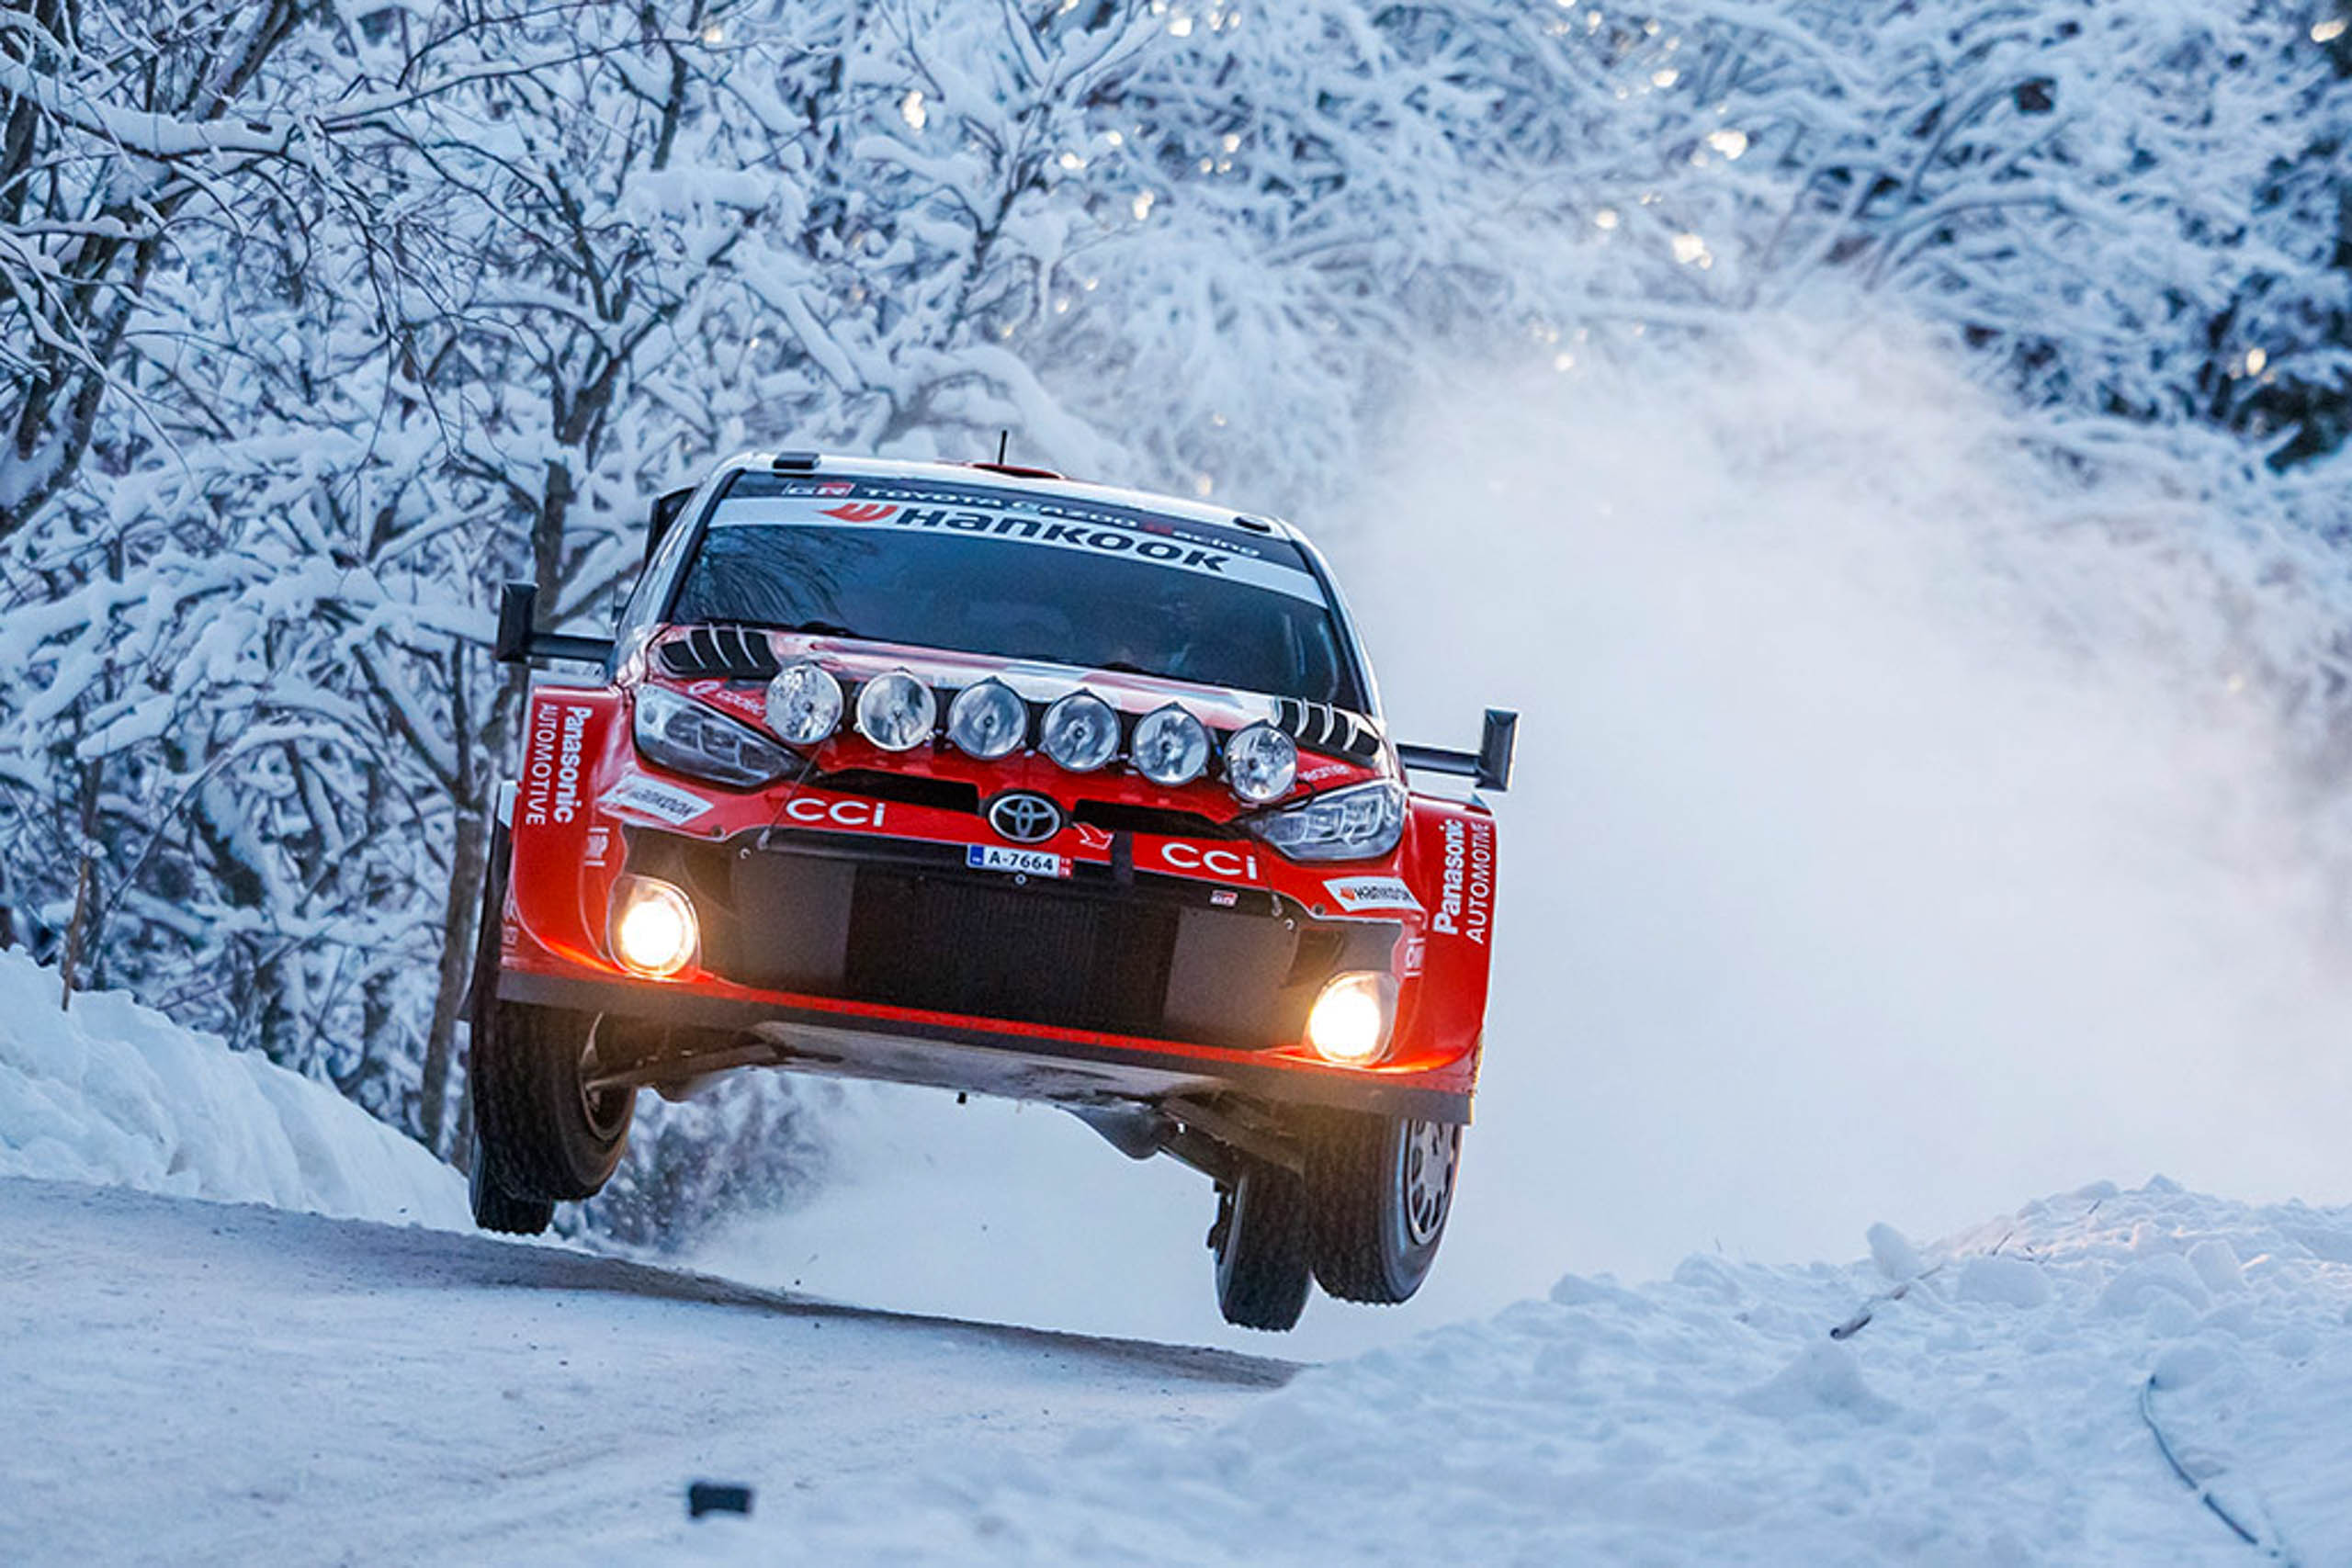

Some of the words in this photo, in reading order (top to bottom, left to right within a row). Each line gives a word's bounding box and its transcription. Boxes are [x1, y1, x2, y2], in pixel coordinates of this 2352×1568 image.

[863, 487, 1001, 507] TOYOTA
[526, 703, 559, 825] AUTOMOTIVE
[553, 705, 594, 823] Panasonic
[989, 851, 1053, 870] A-7664
[1432, 818, 1465, 935] Panasonic
[1465, 821, 1490, 945] AUTOMOTIVE
